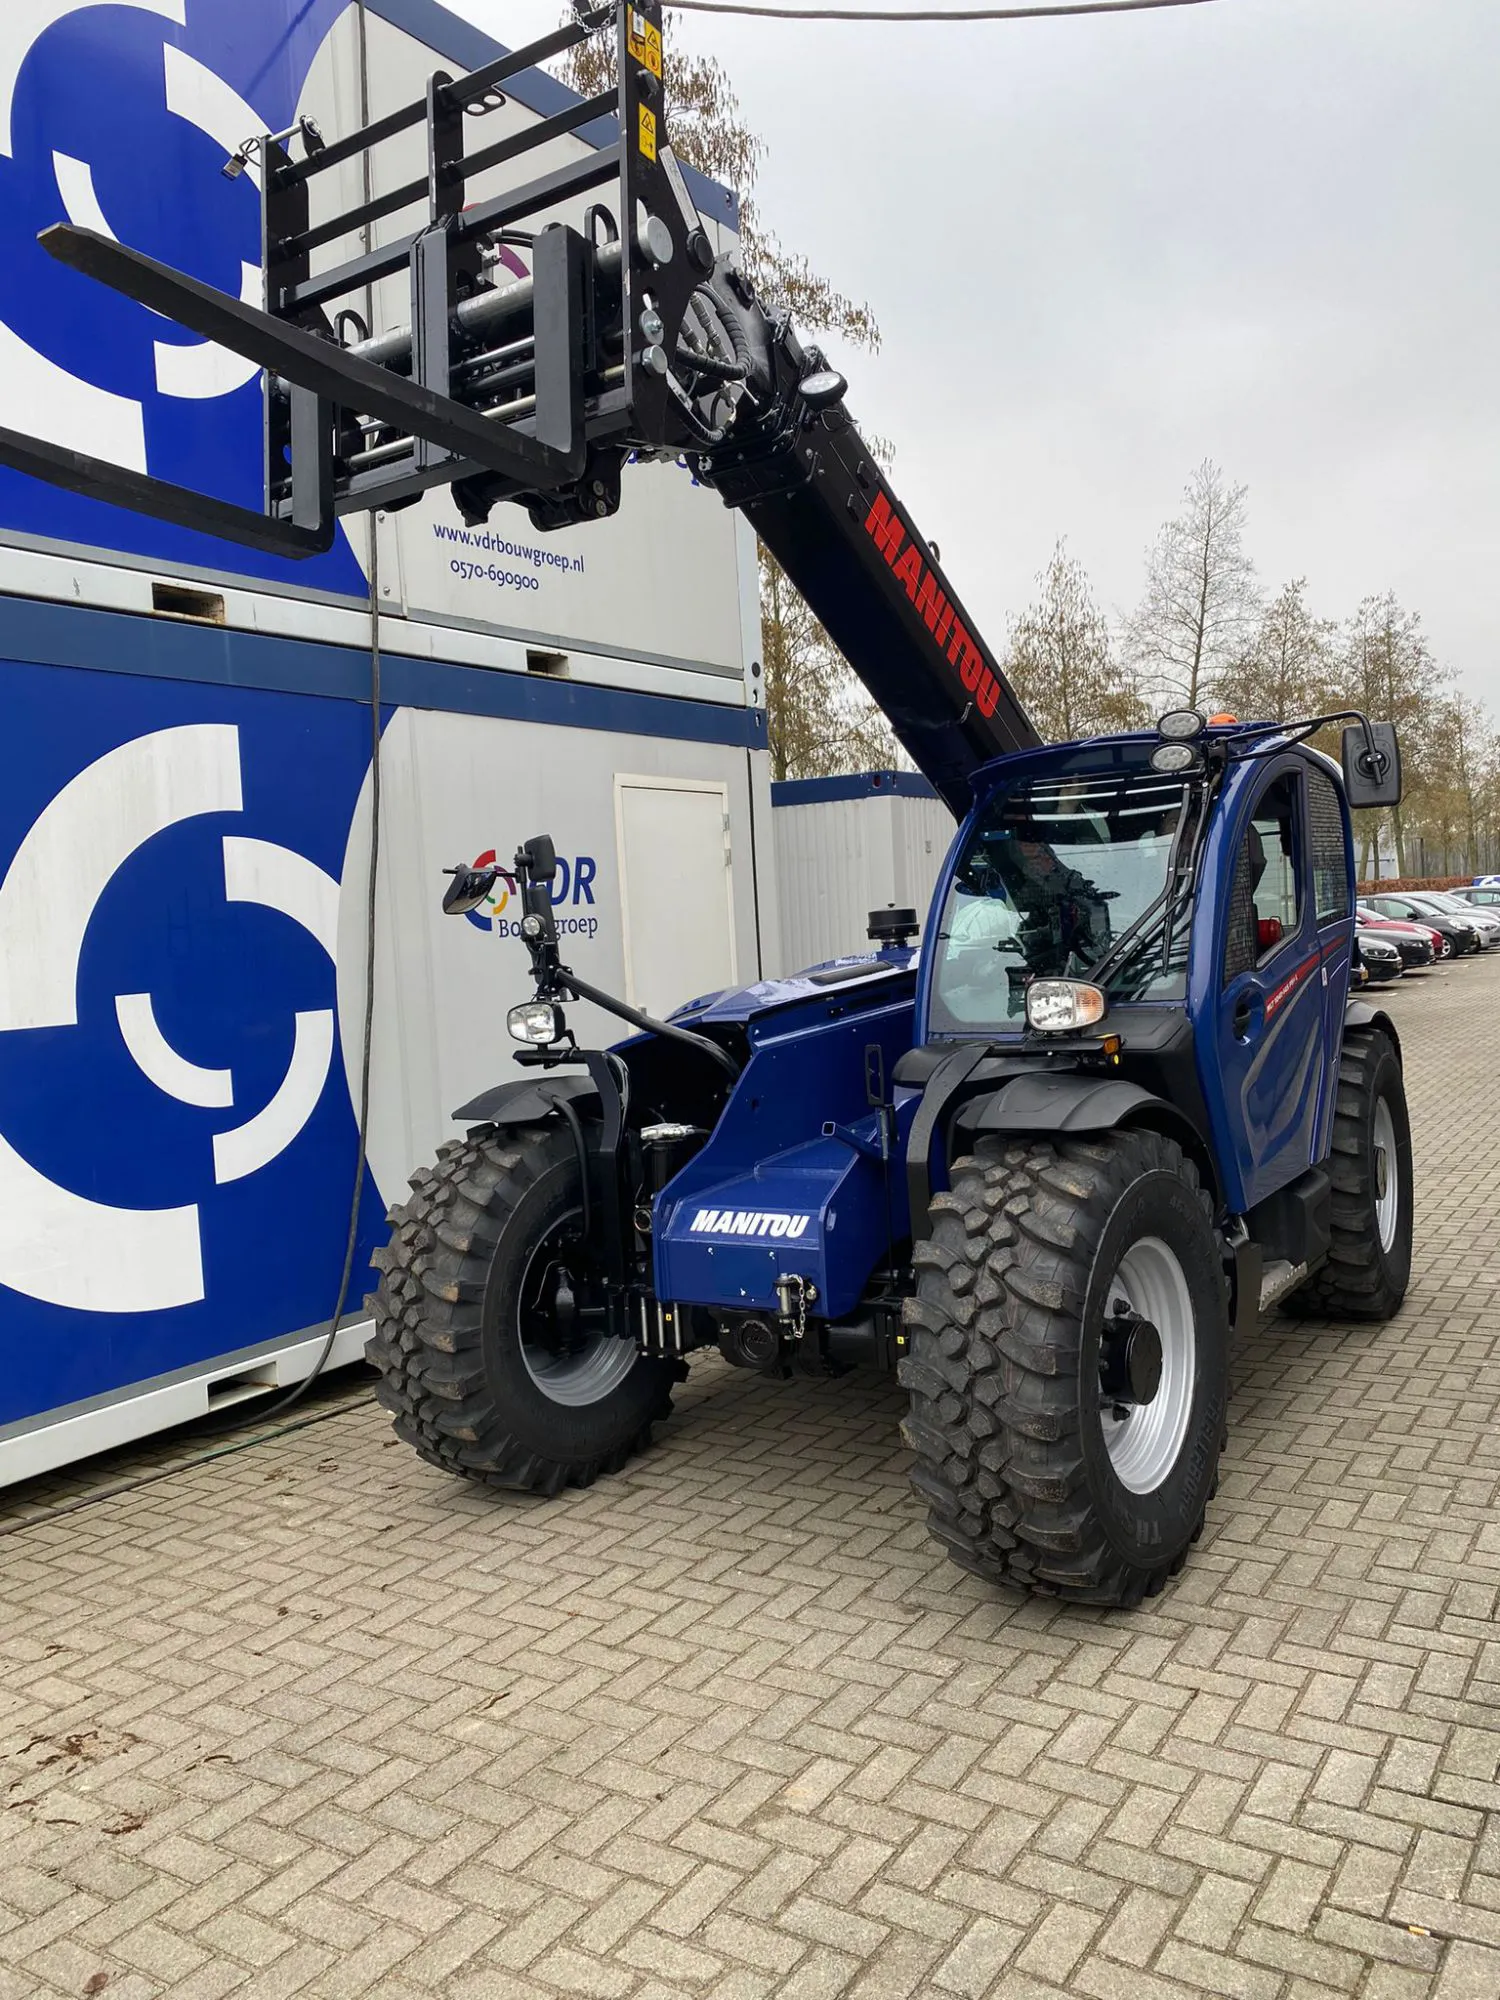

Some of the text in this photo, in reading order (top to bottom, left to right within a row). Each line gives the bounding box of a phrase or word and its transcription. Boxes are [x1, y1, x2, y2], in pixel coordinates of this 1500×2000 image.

[433, 524, 584, 573] www.vdrbouwgroep.nl
[450, 559, 539, 590] 0570-690900
[864, 490, 1000, 719] MANITOU
[528, 857, 596, 905] DR
[690, 1209, 810, 1238] MANITOU
